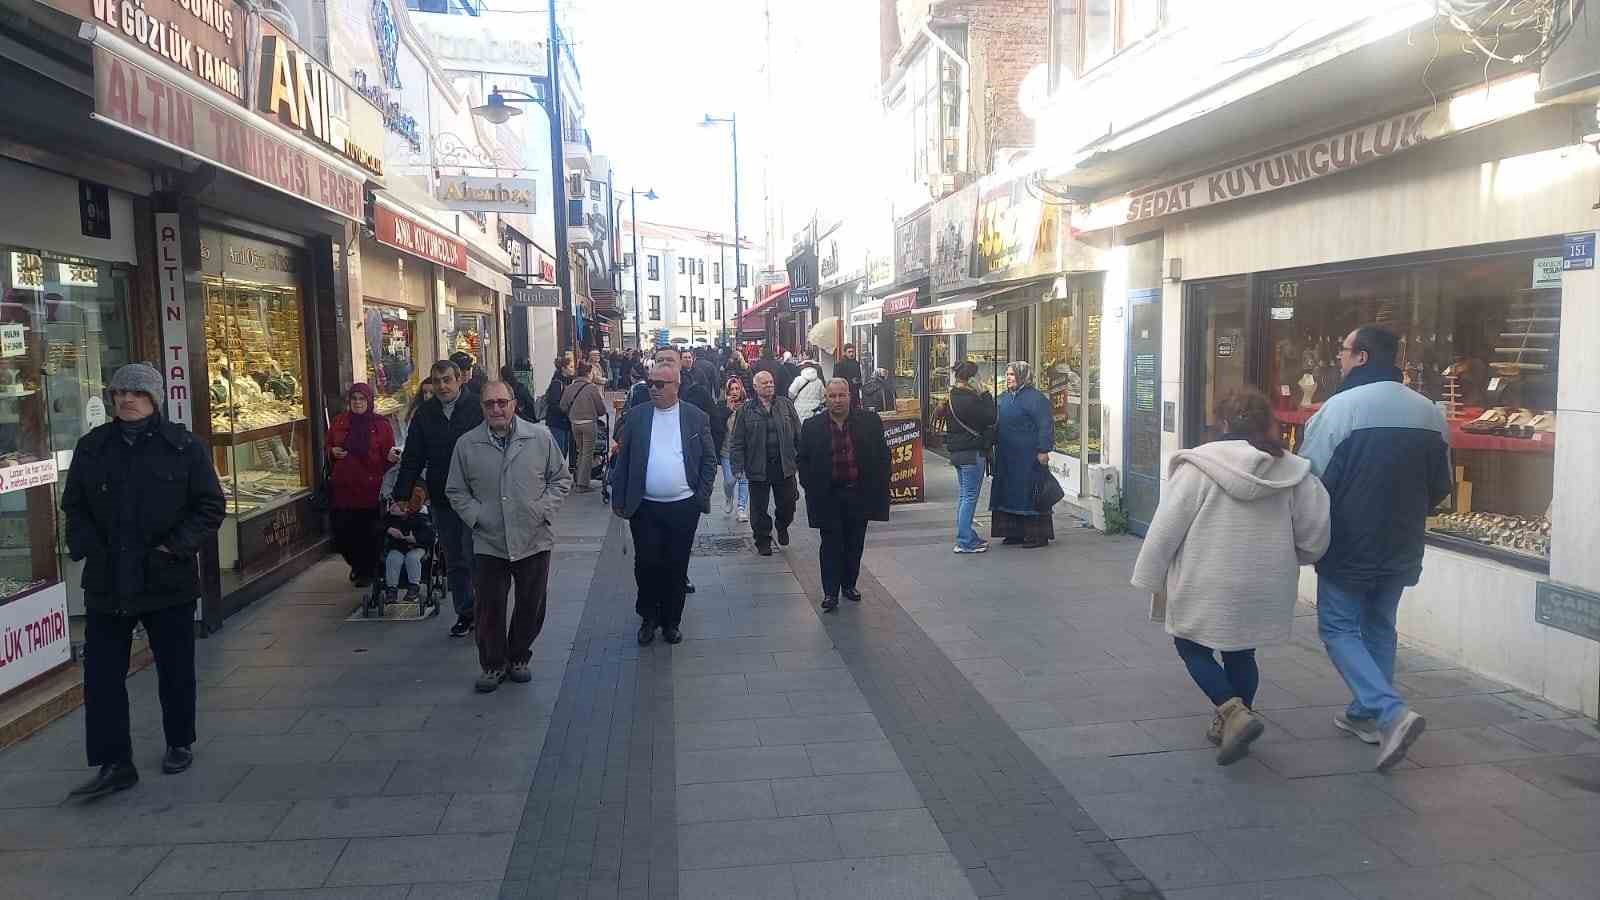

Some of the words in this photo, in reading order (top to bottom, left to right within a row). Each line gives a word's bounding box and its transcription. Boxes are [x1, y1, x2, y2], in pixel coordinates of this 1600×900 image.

[121, 0, 192, 71] GÖZLÜK
[105, 58, 194, 146] ALTIN
[264, 34, 345, 151] ANIL
[1126, 182, 1194, 221] SEDAT
[1208, 111, 1427, 202] KUYUMCULUK
[161, 226, 182, 322] ALTIN
[1570, 244, 1586, 257] 151
[25, 602, 66, 653] TAMİRİ
